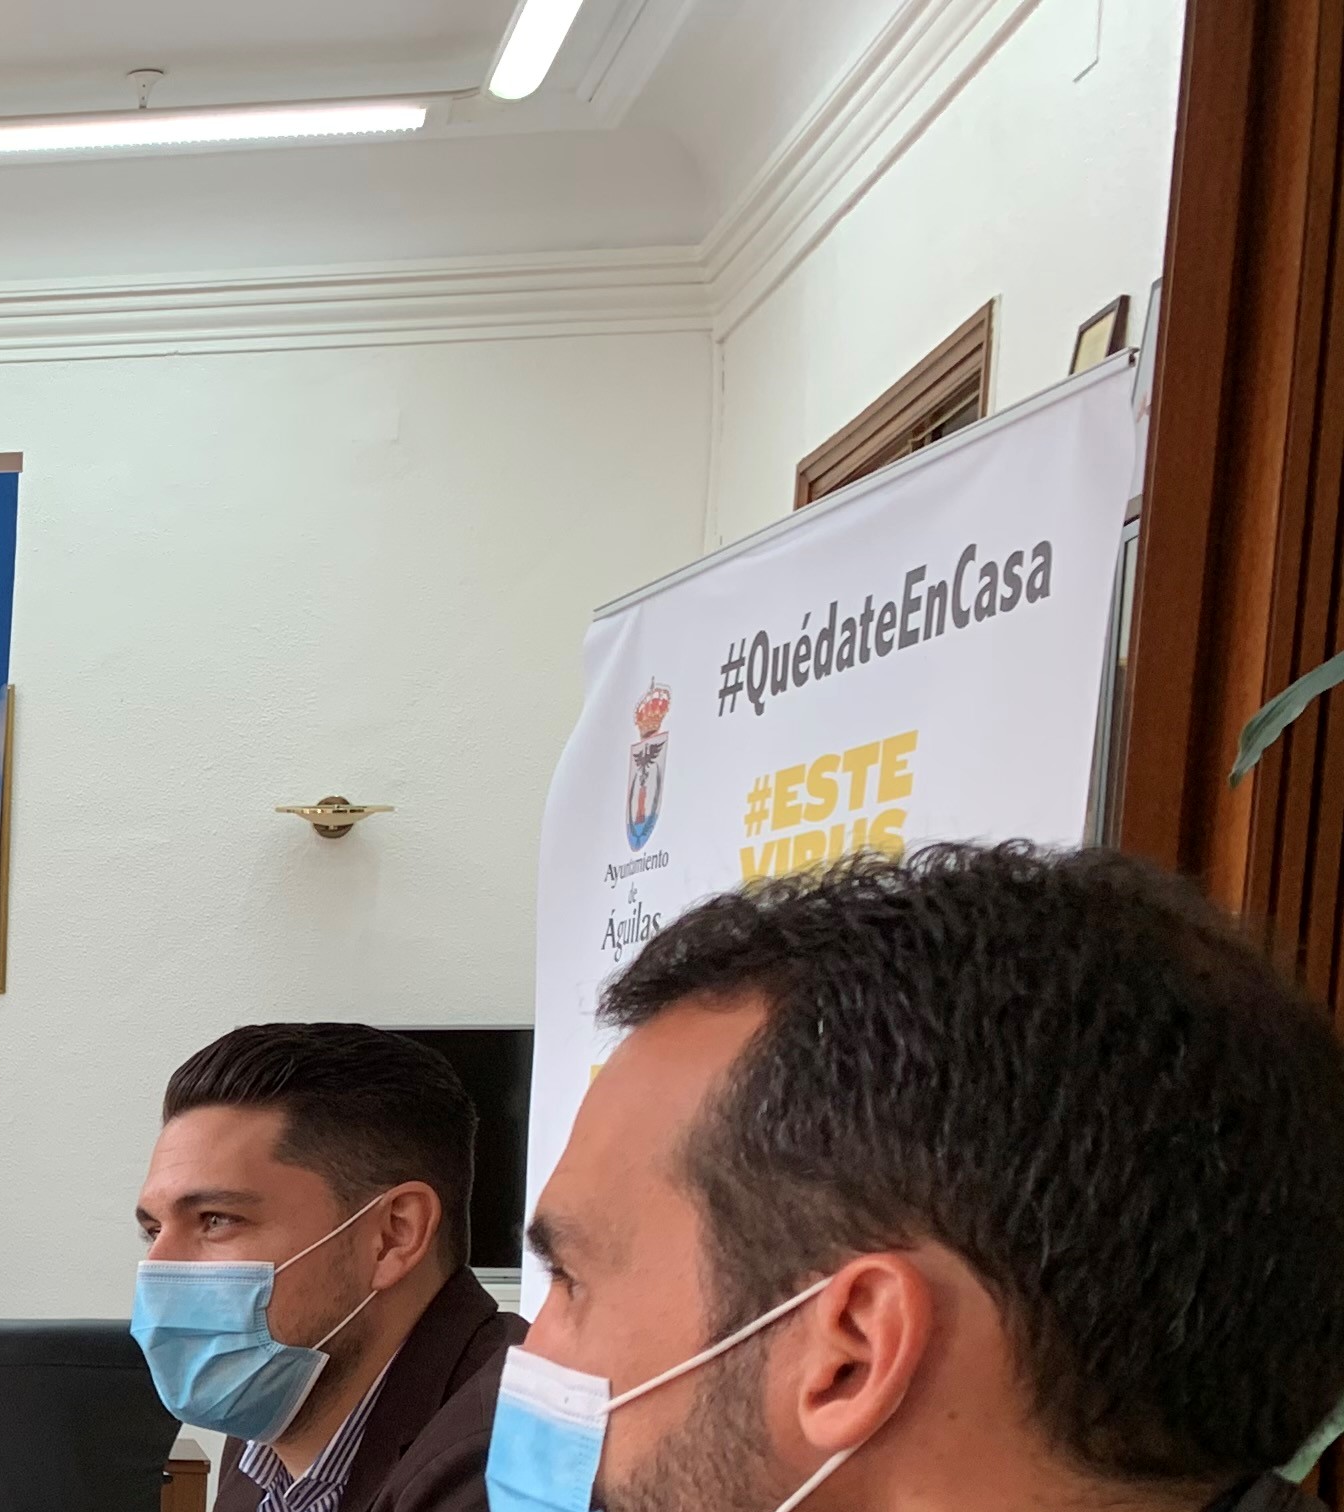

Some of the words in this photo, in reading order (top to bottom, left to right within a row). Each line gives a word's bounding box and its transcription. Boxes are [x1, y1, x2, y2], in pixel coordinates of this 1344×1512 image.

[718, 540, 1053, 717] #QuédateEnCasa
[744, 729, 919, 838] #ESTE
[601, 901, 662, 962] Águilas
